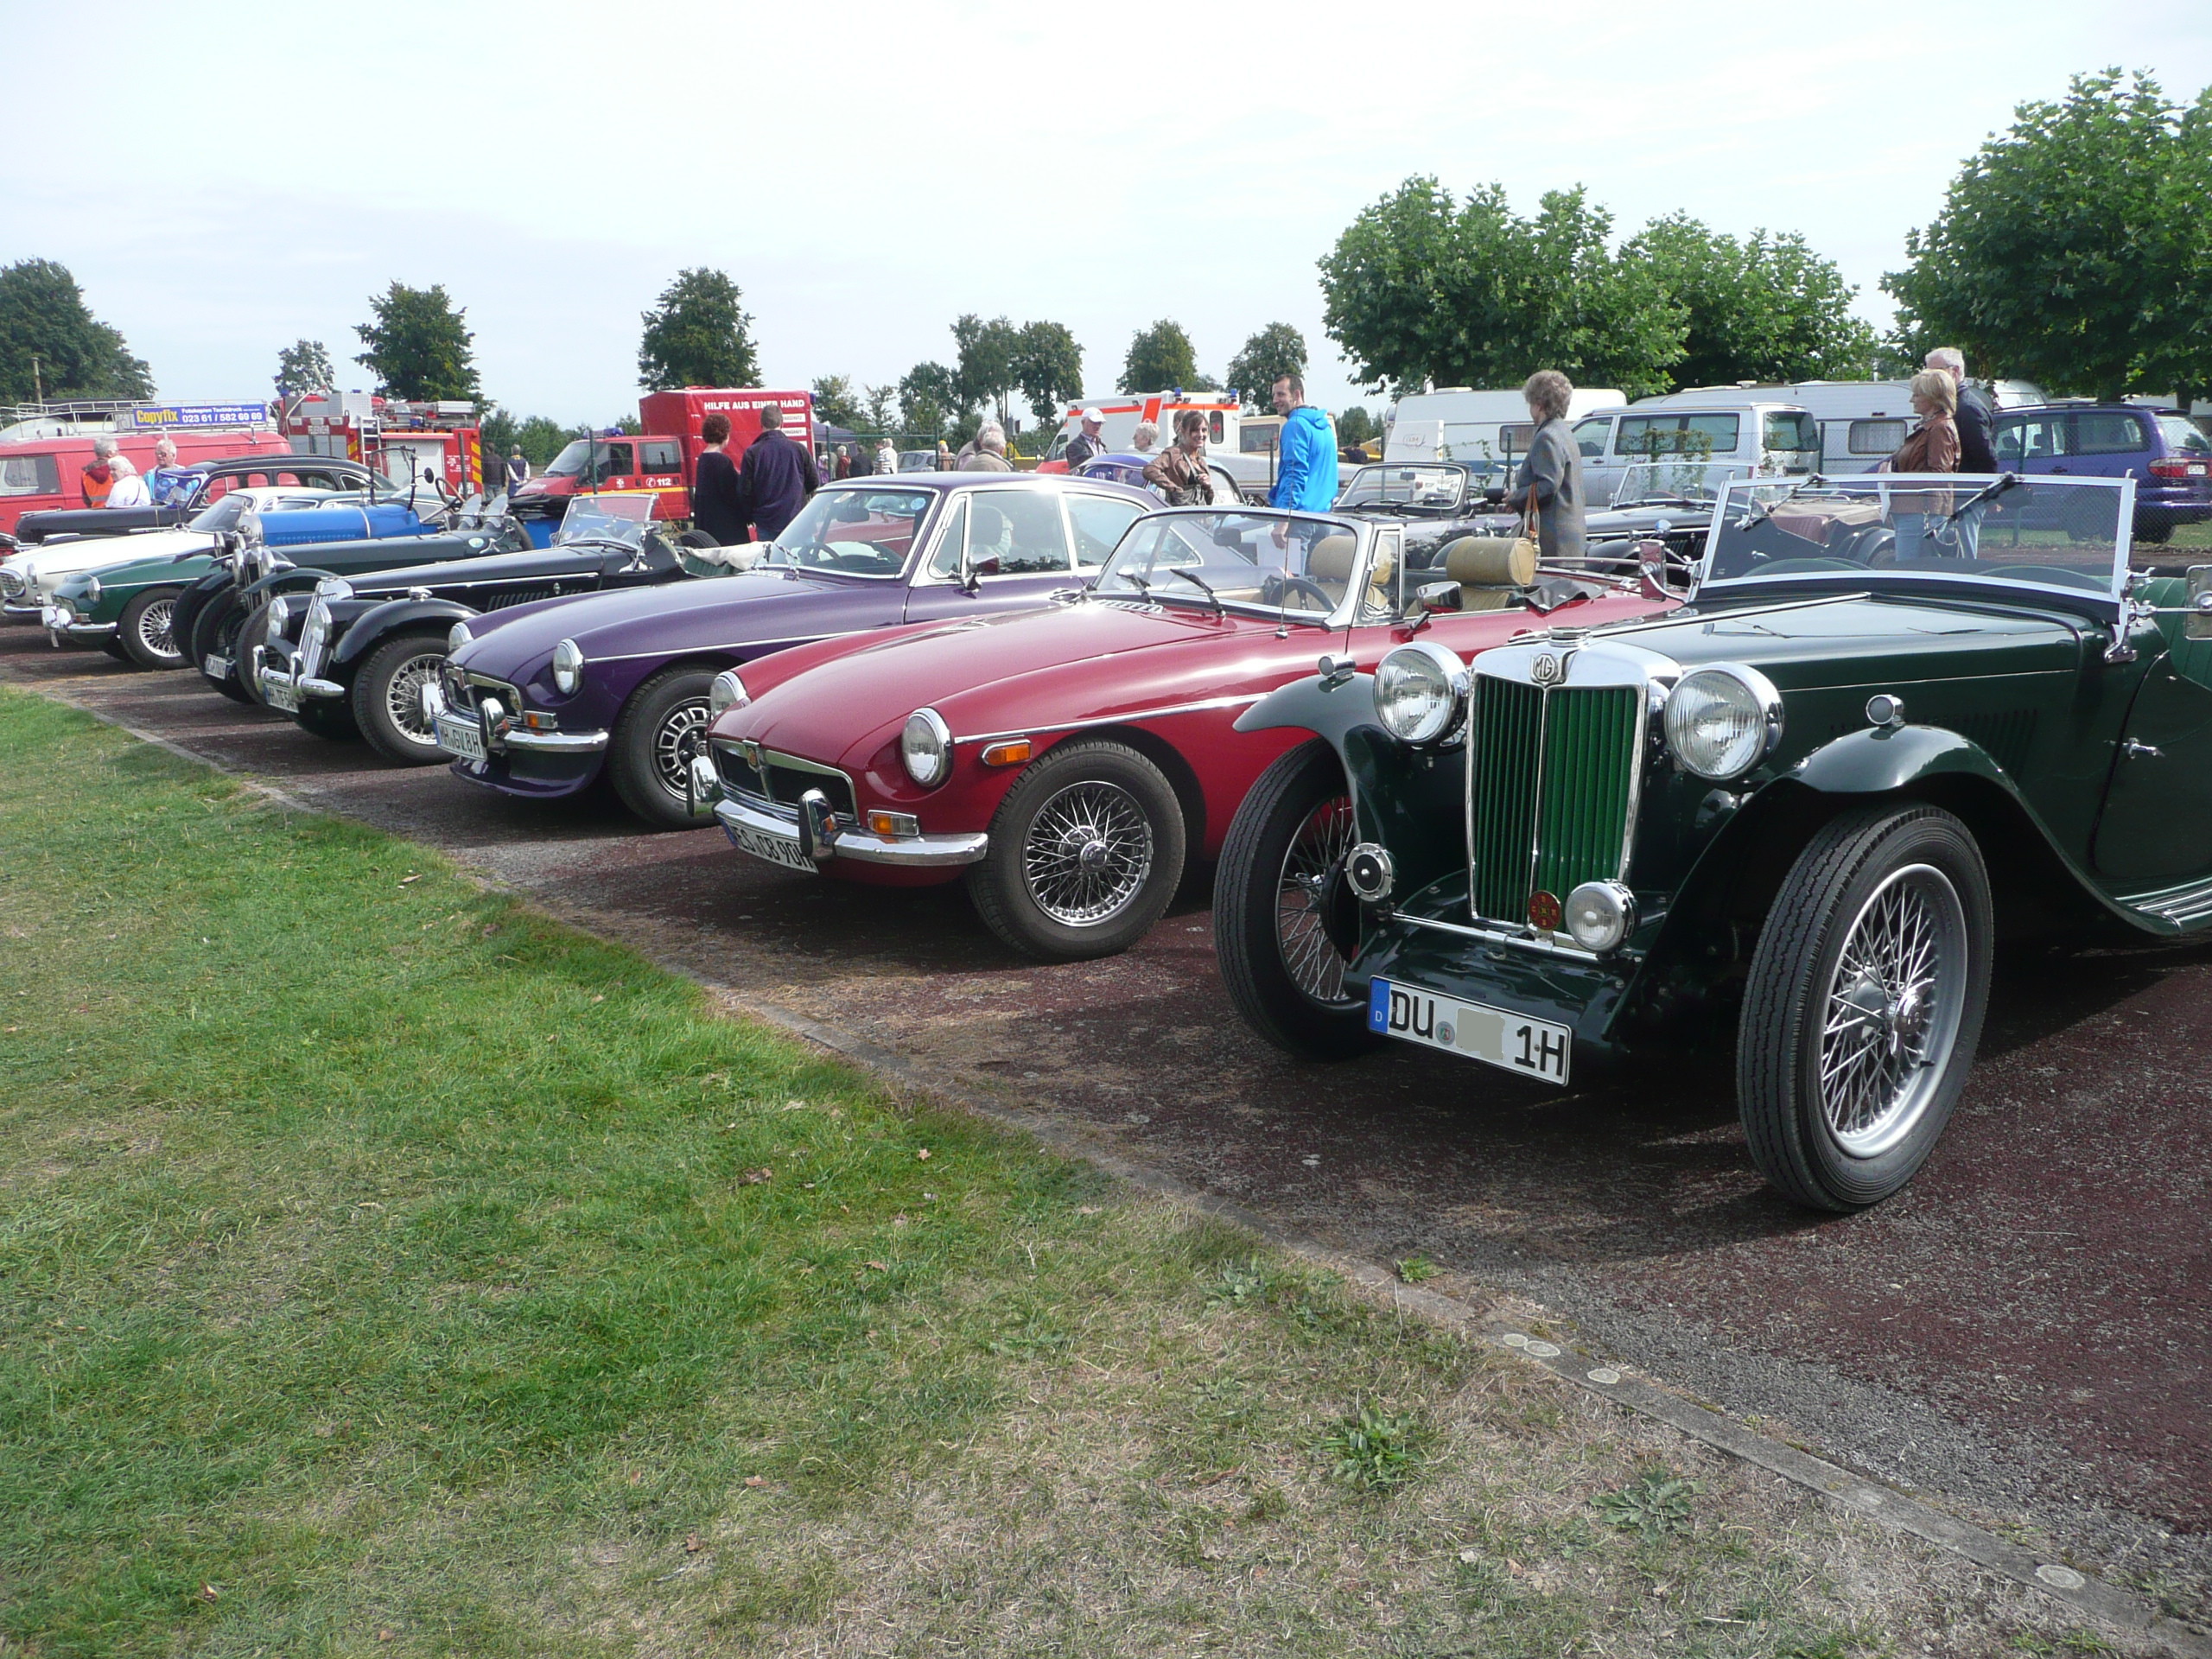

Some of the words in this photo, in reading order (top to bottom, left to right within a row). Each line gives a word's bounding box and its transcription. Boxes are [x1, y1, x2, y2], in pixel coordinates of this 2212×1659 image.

[732, 401, 750, 410] AUS
[780, 399, 804, 408] HAND
[137, 409, 178, 423] Copyfix
[1535, 657, 1553, 677] MG
[756, 834, 781, 861] CB
[1375, 1010, 1382, 1022] D
[1389, 989, 1434, 1039] DU
[1515, 1025, 1565, 1077] 1H
